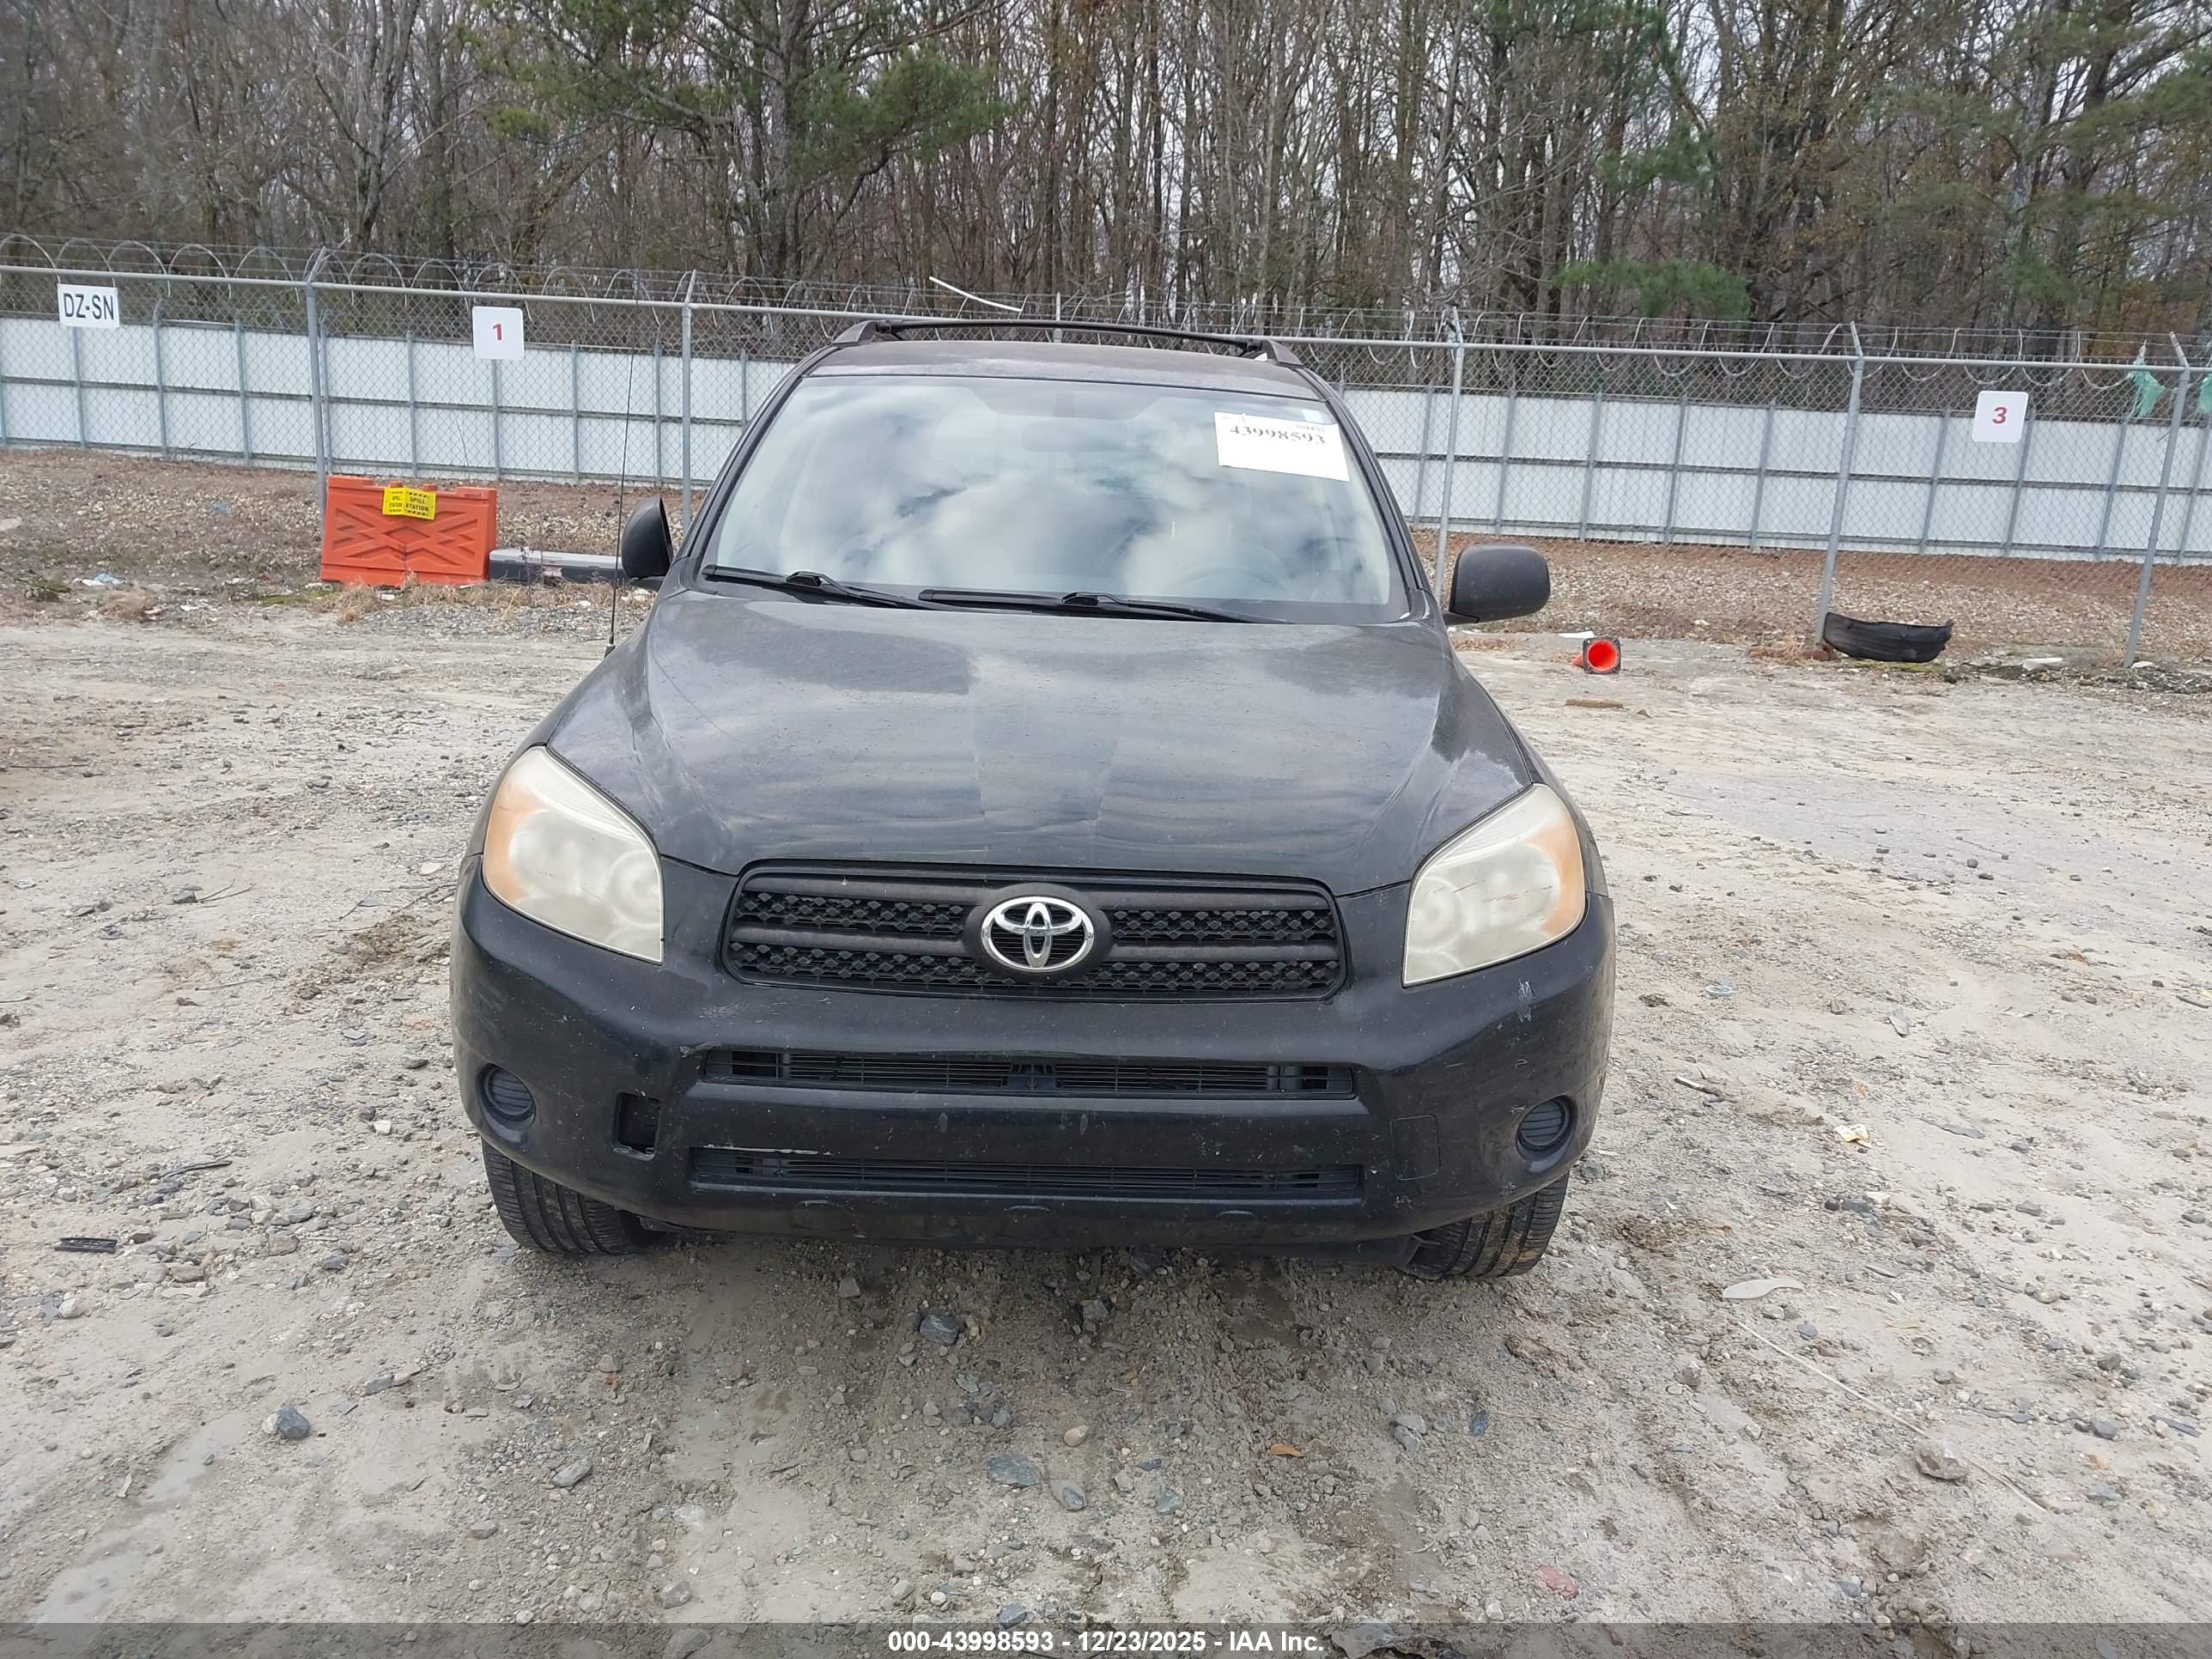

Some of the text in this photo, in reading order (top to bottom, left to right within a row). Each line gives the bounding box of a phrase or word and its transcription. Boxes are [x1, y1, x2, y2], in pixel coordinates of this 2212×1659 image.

[64, 293, 114, 320] DZ-SN
[493, 323, 501, 341] 1
[1992, 406, 2007, 424] 3
[1230, 425, 1326, 445] 43998593
[406, 503, 429, 512] STATION
